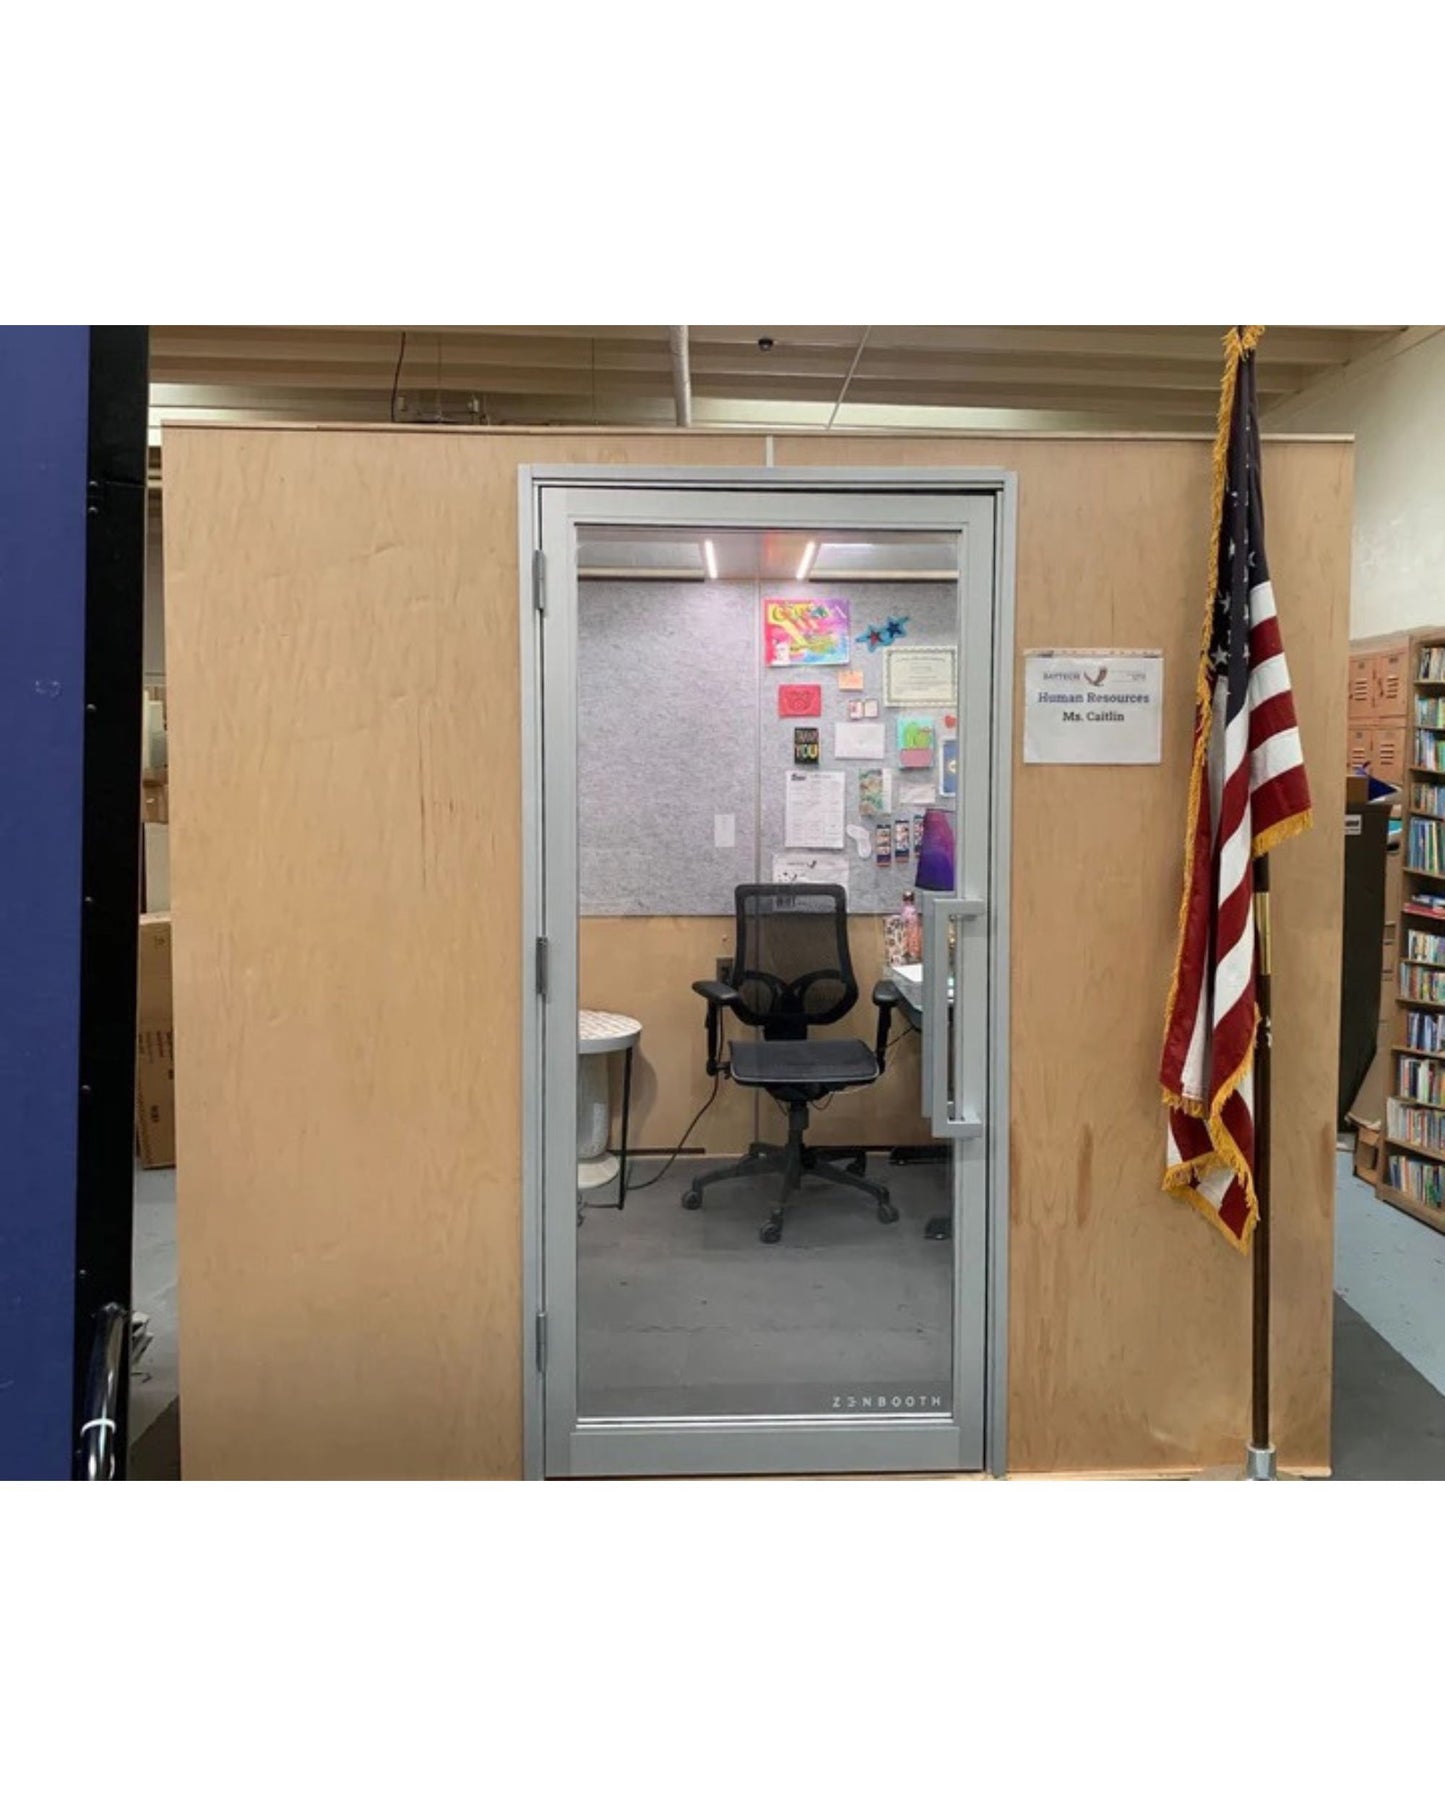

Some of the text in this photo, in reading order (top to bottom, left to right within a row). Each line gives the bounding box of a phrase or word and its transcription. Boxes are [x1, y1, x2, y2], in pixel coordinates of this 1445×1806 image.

[1038, 692, 1150, 703] Human Resources
[1062, 711, 1125, 722] Ms. Caitlin
[795, 744, 818, 759] YOU
[832, 1395, 941, 1407] ZENBOOTH
